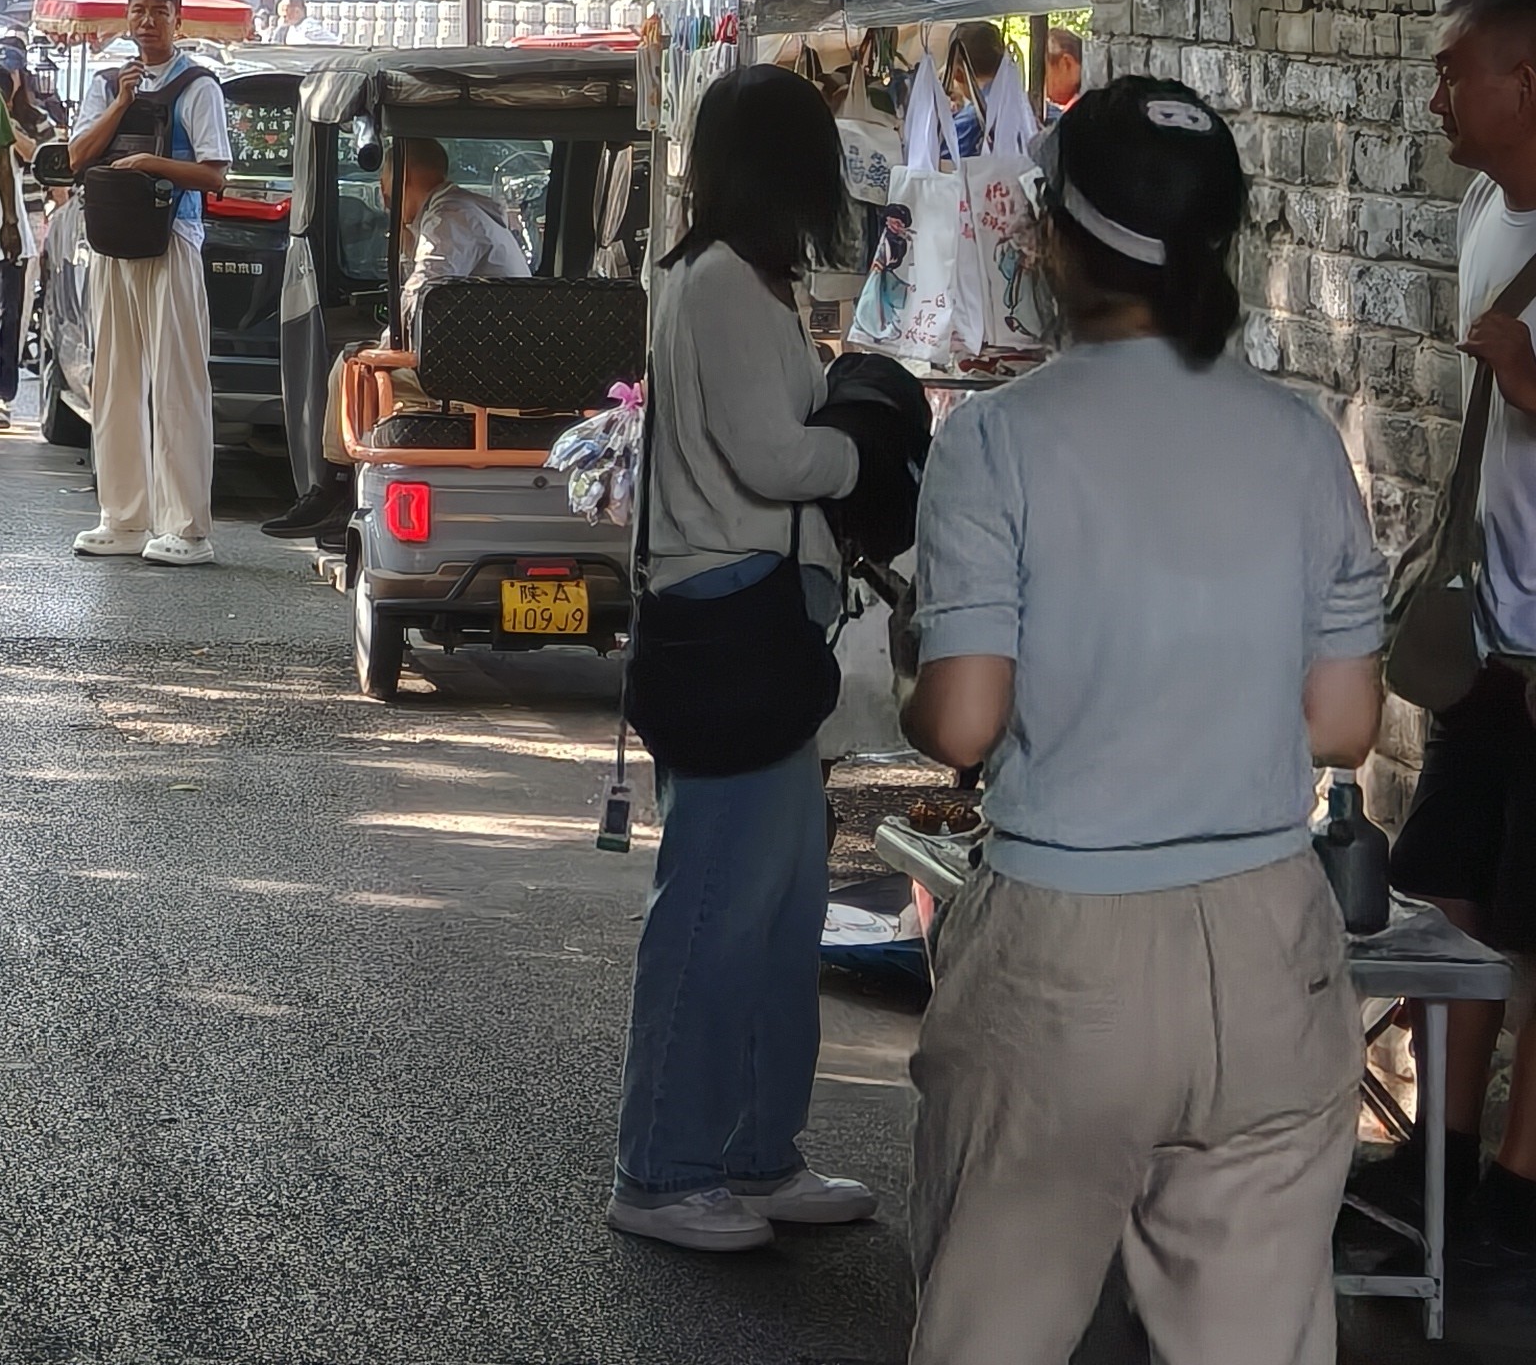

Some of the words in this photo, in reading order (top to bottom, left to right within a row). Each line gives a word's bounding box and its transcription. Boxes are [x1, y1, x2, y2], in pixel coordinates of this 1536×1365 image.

[211, 261, 263, 275] 东风本田
[511, 607, 584, 632] 109J9
